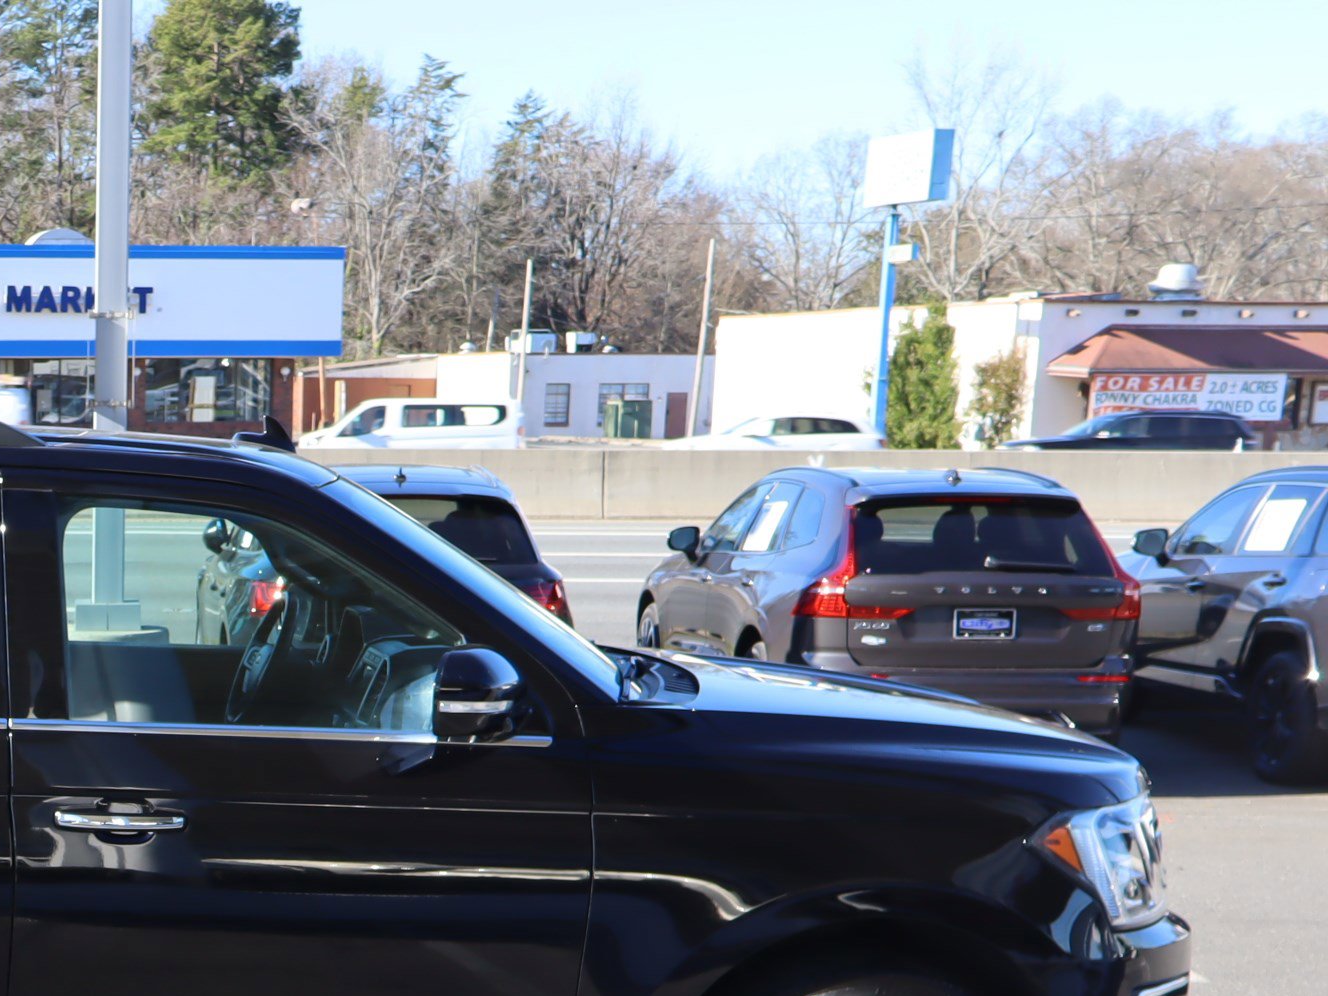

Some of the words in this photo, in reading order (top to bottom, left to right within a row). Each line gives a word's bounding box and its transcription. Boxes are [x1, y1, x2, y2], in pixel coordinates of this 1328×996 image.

[5, 285, 154, 314] MART
[1094, 376, 1141, 391] FOR
[1148, 376, 1204, 391] SALE
[1240, 380, 1279, 395] ACRES
[1143, 393, 1198, 406] CHAKRA
[1207, 400, 1254, 413] ZONED
[1258, 400, 1277, 413] CG
